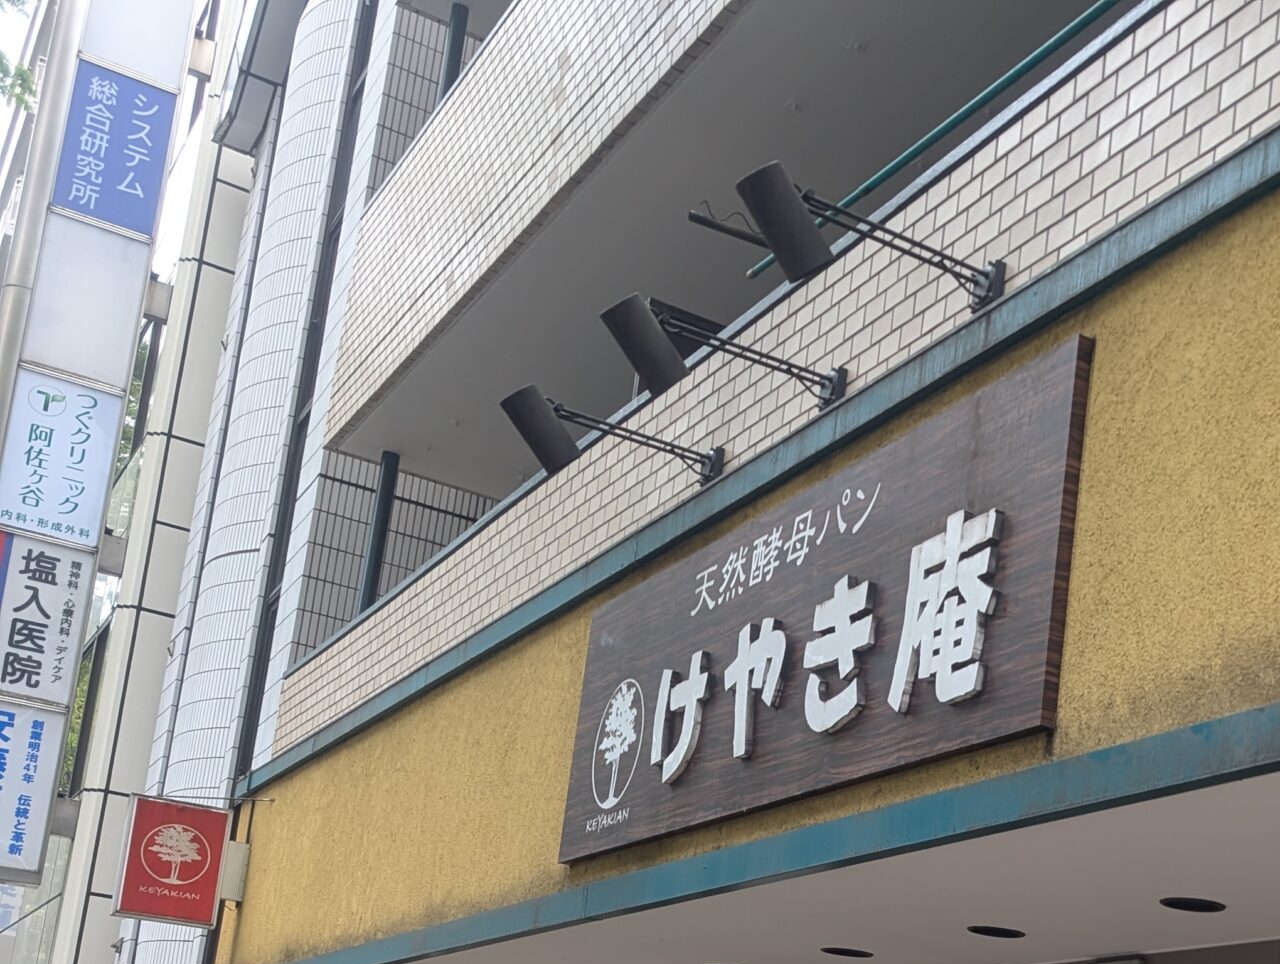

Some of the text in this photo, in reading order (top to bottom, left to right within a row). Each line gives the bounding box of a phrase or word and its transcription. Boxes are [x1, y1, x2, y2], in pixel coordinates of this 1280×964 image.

[68, 76, 120, 210] 総合研究所
[116, 93, 160, 199] システム
[58, 393, 98, 515] つぐクリニック
[689, 482, 881, 617] 天然酵母パン
[1, 548, 61, 688] 塩入医院
[651, 508, 1003, 783] けやき庵
[585, 807, 630, 834] KEYAKIAN
[139, 885, 201, 900] KEYAKIAN
